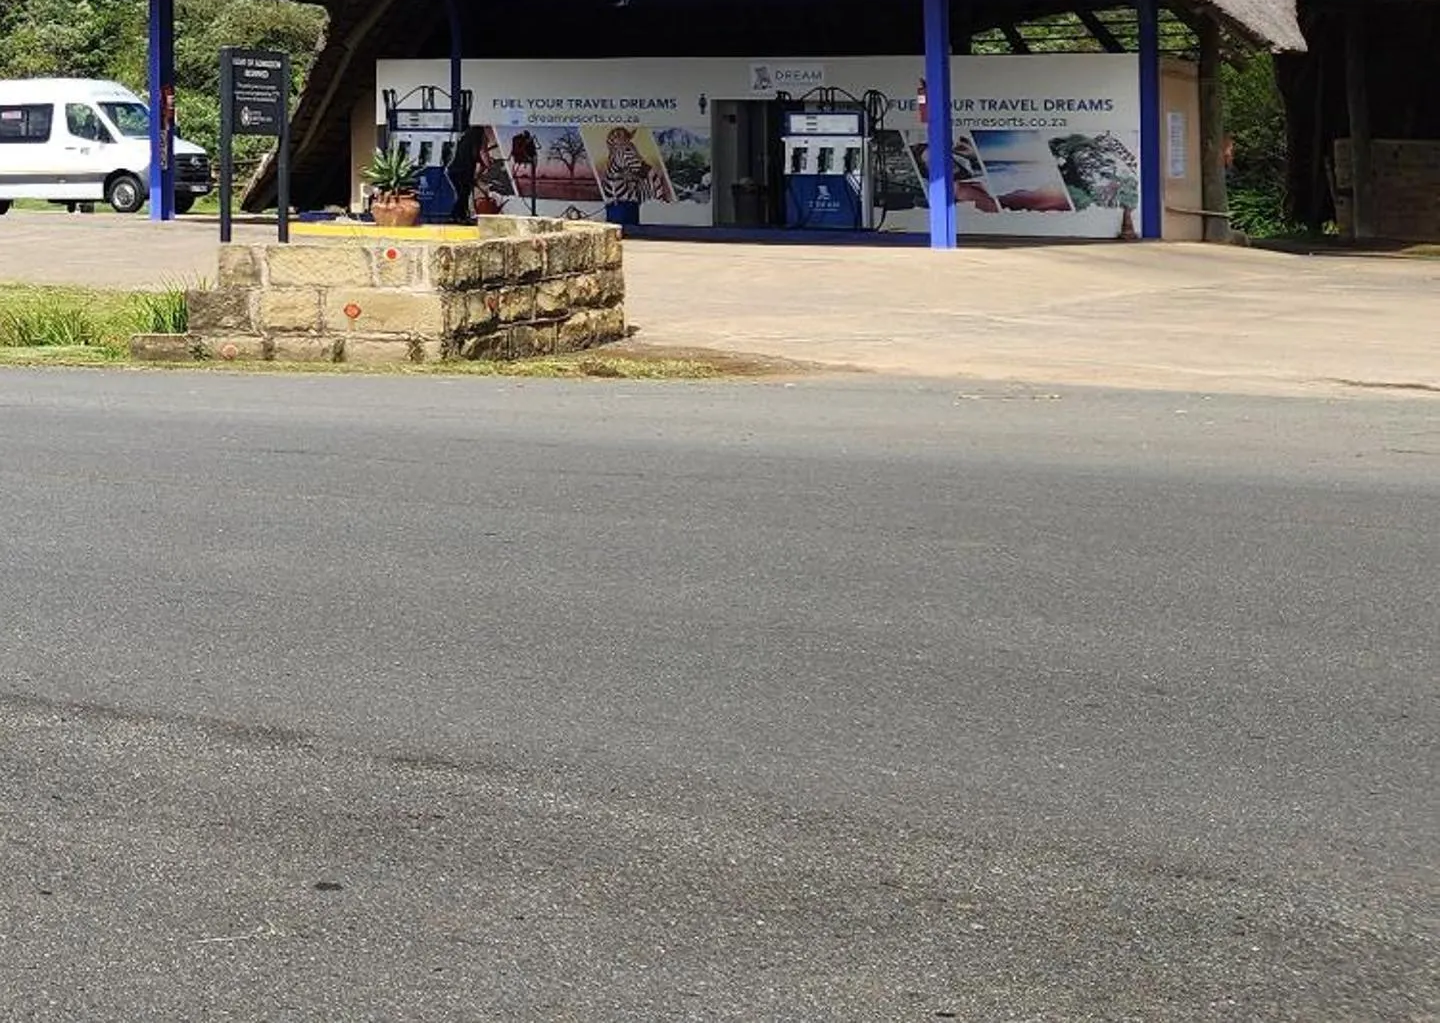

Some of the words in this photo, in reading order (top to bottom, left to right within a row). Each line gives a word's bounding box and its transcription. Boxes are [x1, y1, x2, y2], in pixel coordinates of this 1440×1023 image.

[775, 70, 823, 80] DREAM
[493, 98, 523, 109] FUEL
[527, 98, 563, 109] YOUR
[567, 98, 616, 109] TRAVEL
[619, 98, 677, 109] DREAMS
[979, 99, 1039, 111] TRAVEL
[1043, 99, 1113, 111] DREAMS
